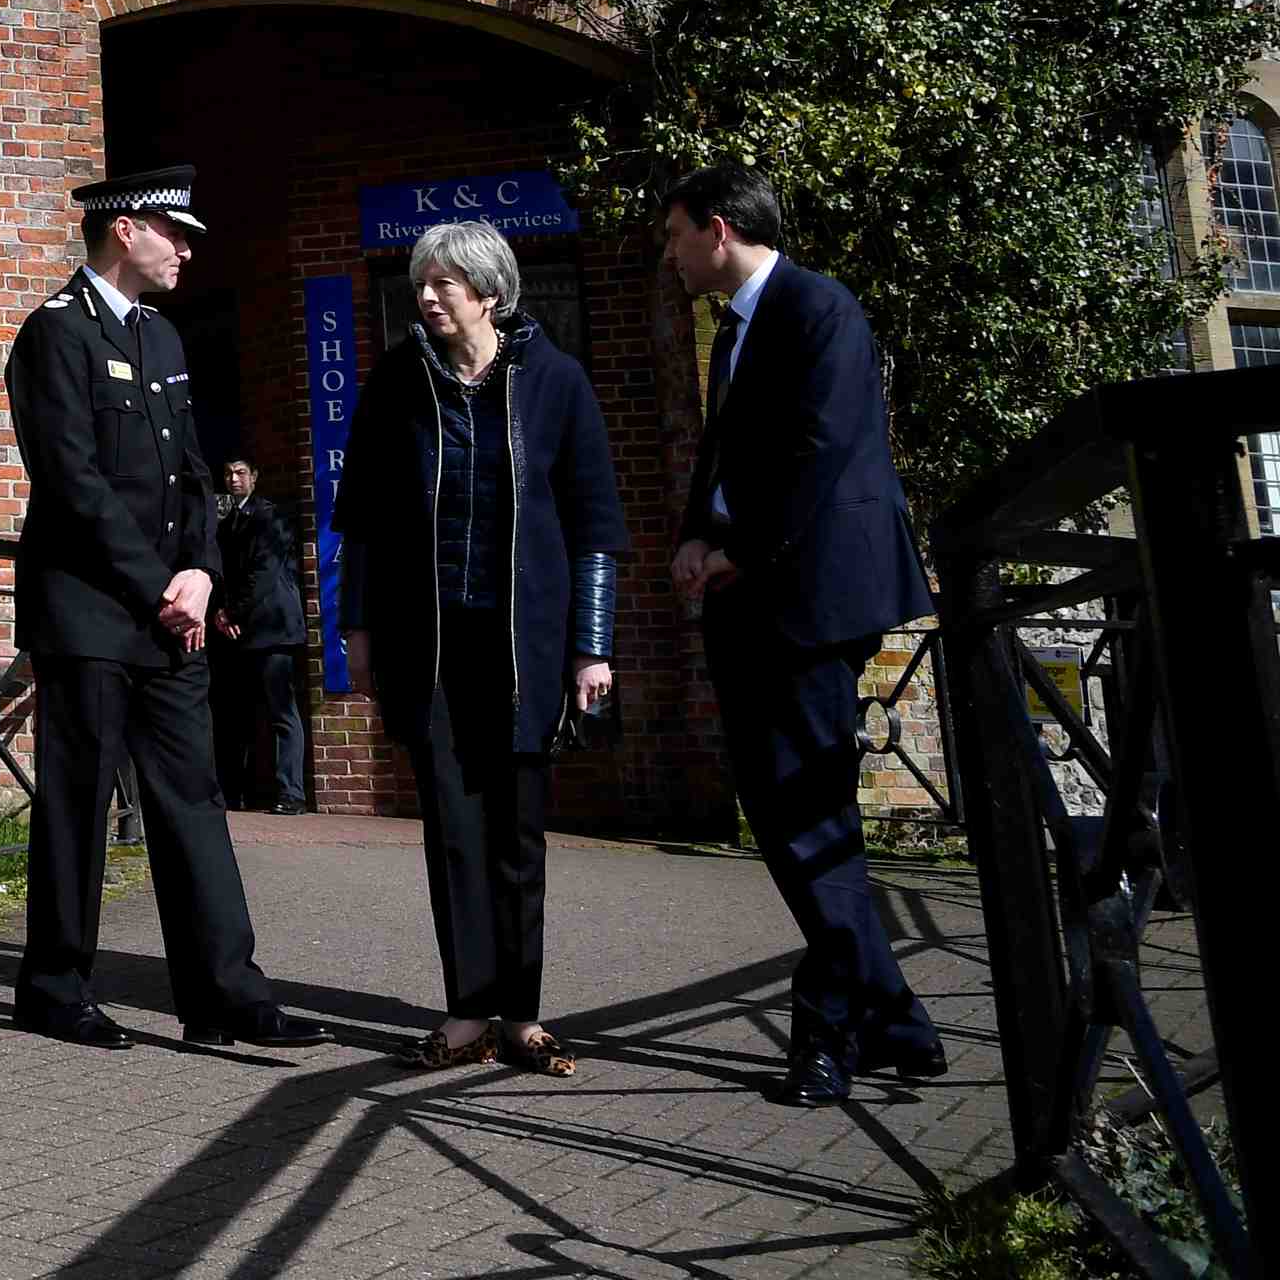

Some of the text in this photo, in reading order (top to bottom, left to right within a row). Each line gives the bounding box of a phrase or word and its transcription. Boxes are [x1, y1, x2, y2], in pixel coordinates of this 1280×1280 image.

[413, 180, 520, 213] K & C
[320, 310, 345, 422] SHOE
